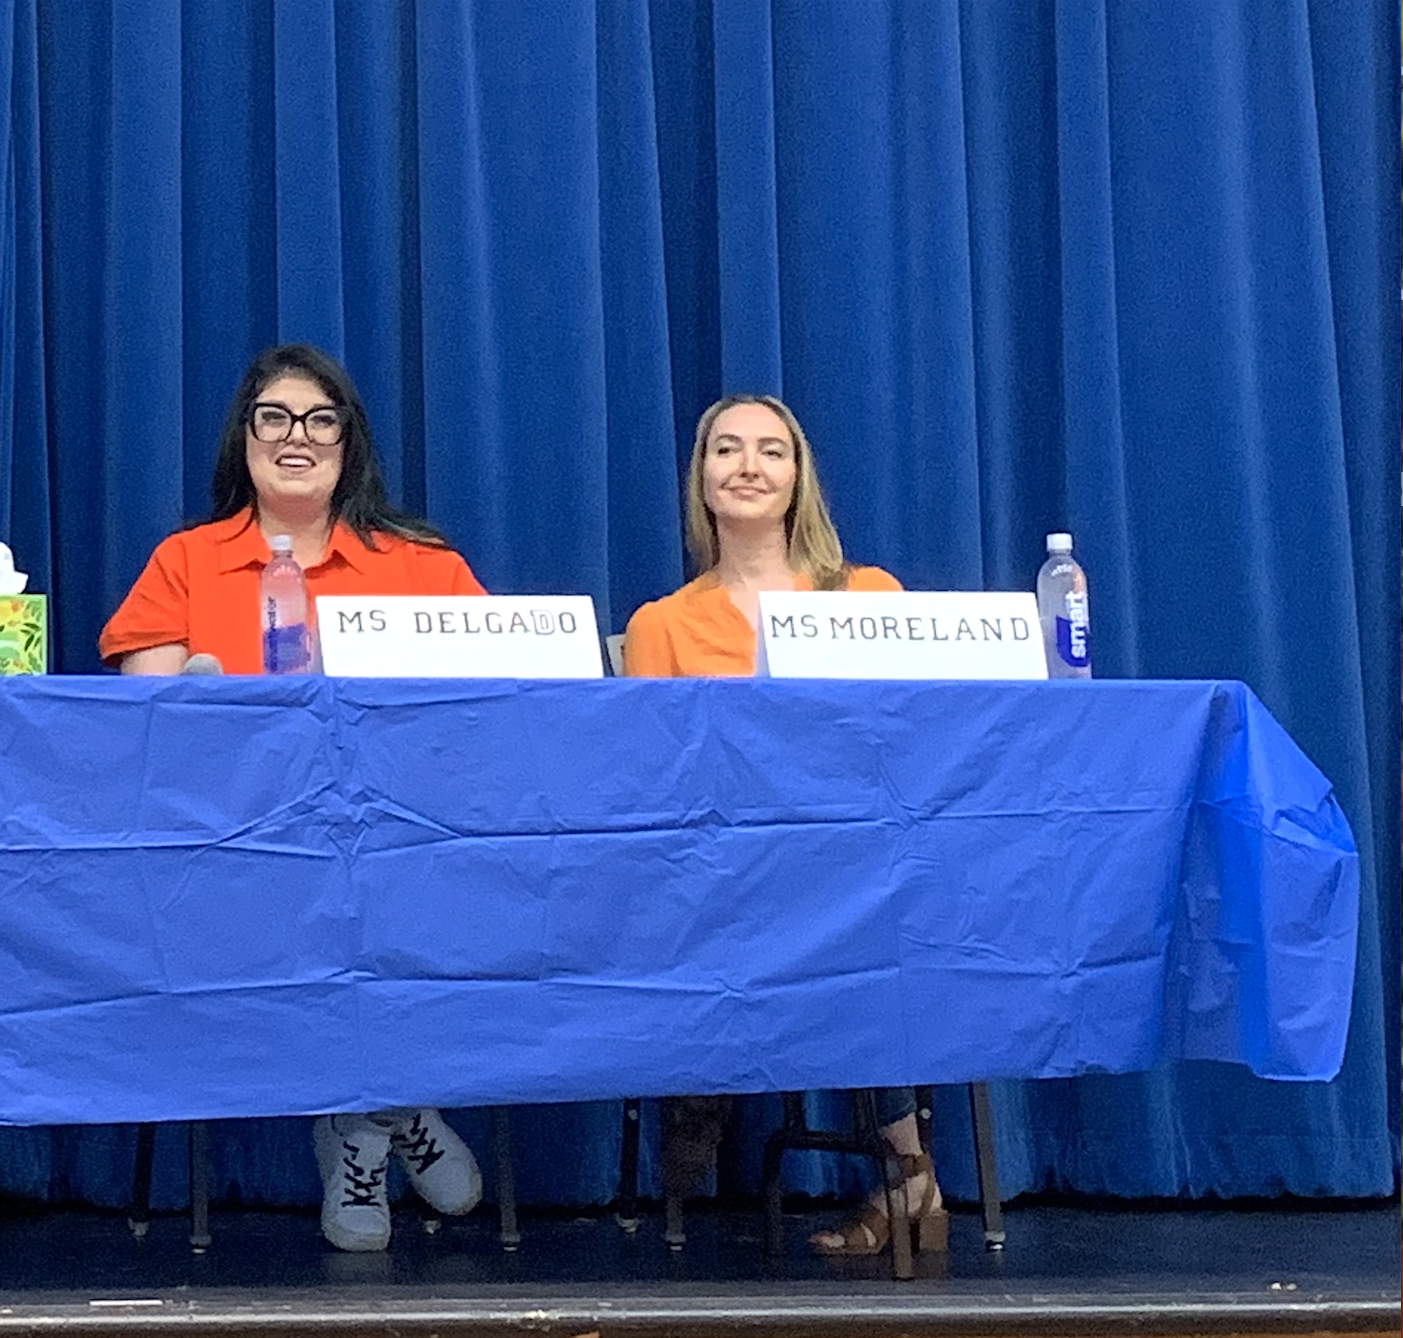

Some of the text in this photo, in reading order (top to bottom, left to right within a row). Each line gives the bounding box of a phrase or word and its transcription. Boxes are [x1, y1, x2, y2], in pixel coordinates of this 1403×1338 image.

[337, 609, 577, 635] MS DELGADO
[770, 615, 1030, 641] MS MORELAND
[1065, 591, 1086, 659] smart
